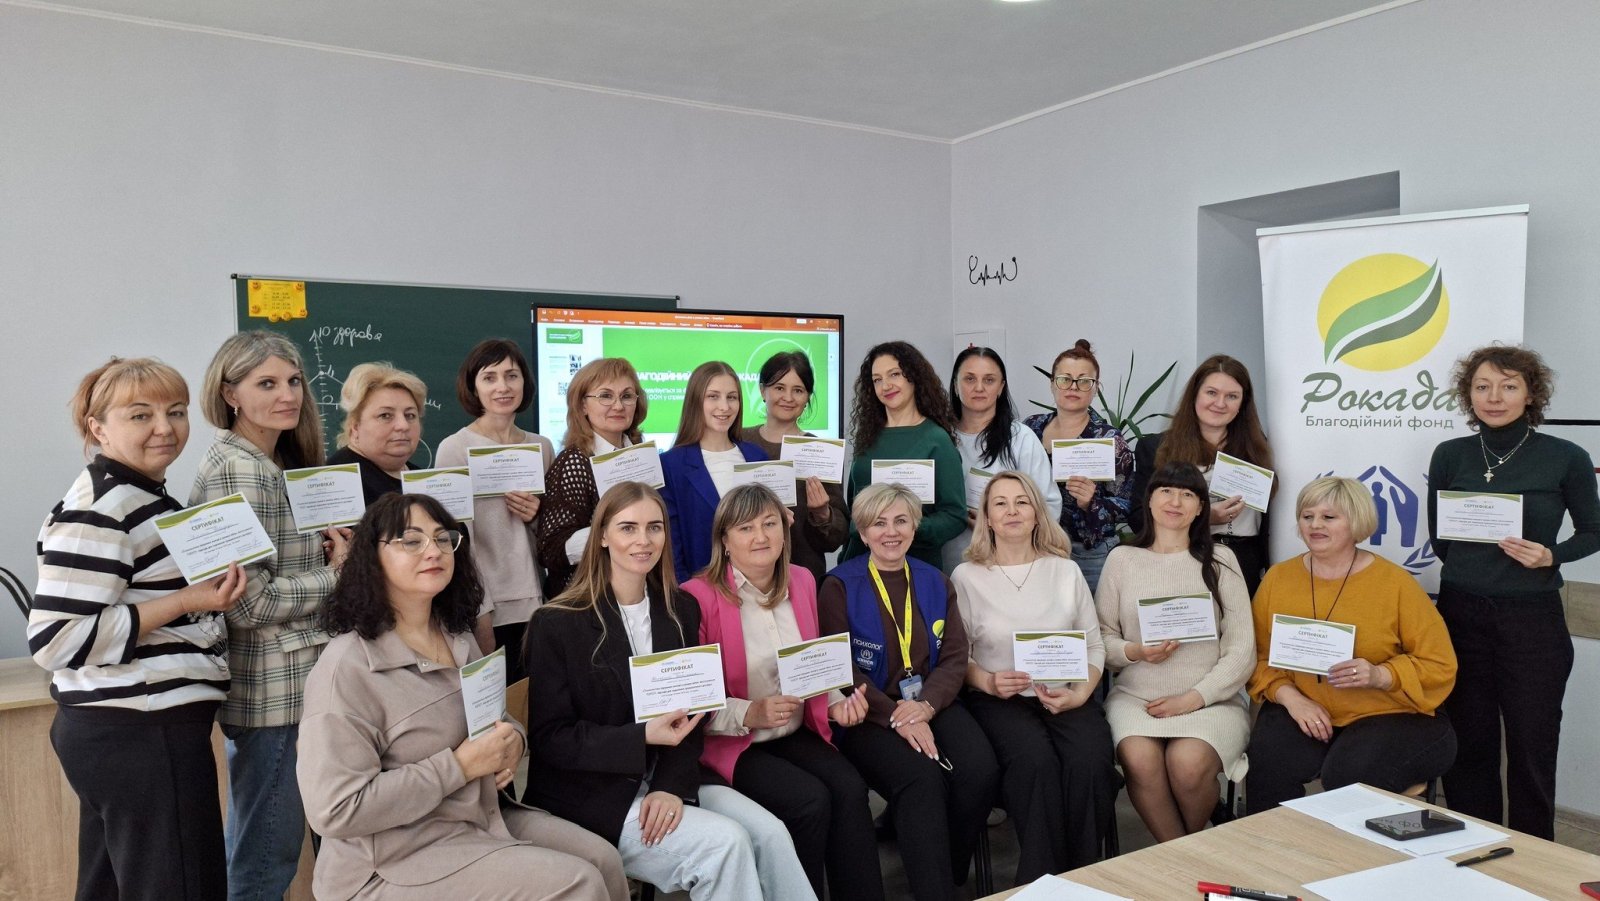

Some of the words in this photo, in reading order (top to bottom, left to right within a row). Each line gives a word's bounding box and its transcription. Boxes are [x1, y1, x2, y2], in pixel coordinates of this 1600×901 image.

[1301, 369, 1460, 413] Рокада
[1305, 415, 1402, 428] Благодійний
[1407, 416, 1454, 431] фонд
